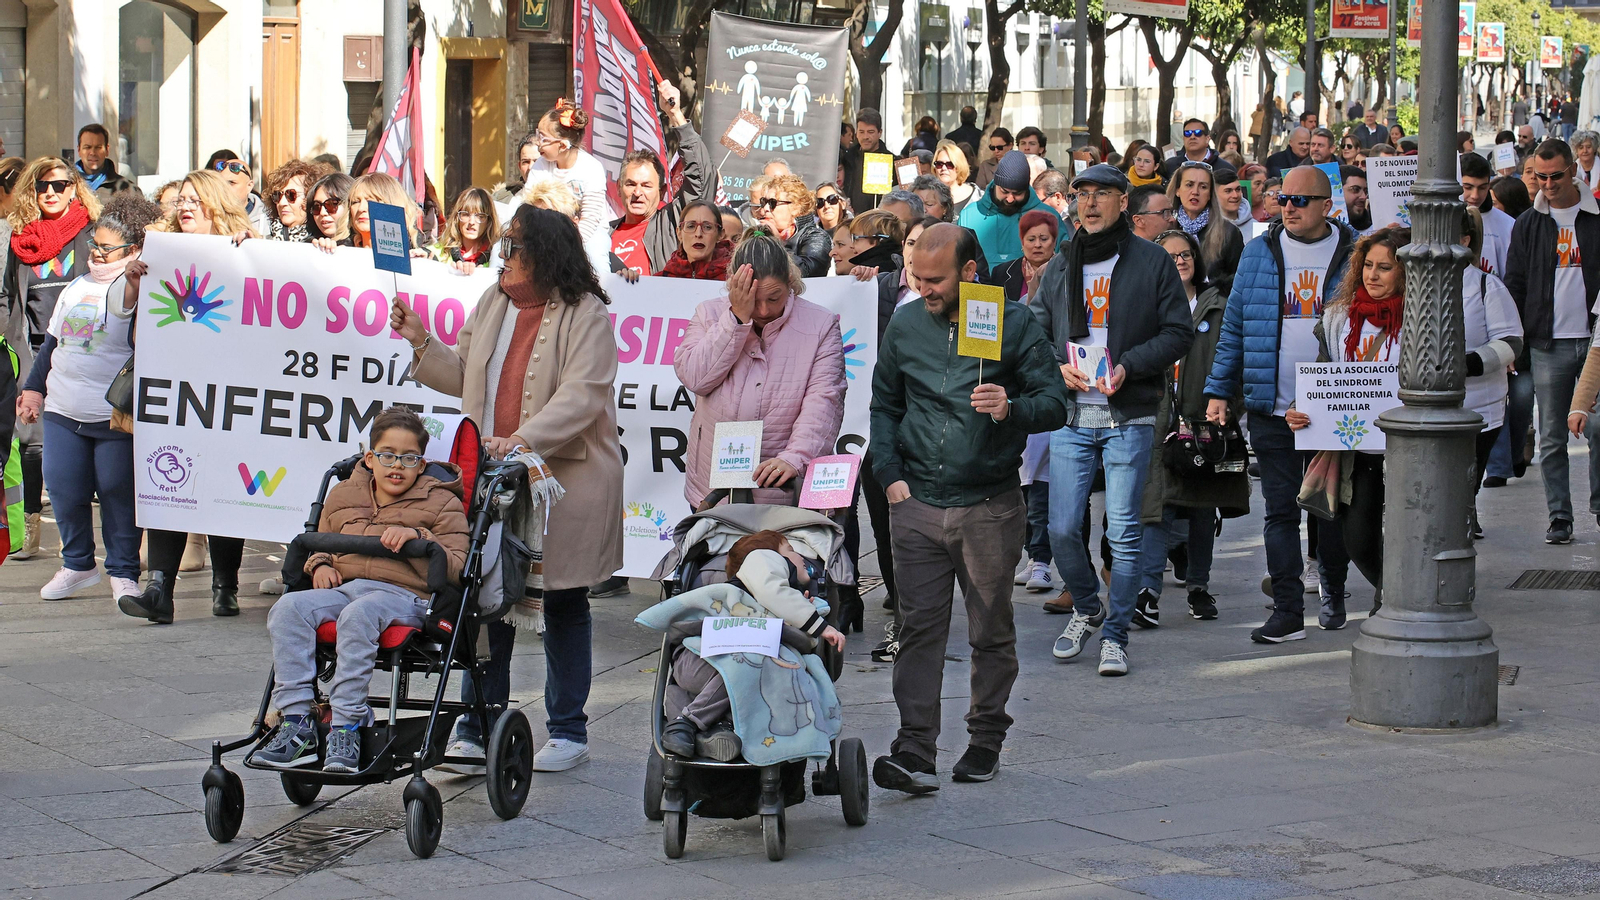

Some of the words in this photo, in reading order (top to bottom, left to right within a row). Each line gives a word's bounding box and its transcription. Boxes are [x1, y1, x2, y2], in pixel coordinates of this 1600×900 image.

[1339, 13, 1354, 27] 27
[1413, 29, 1421, 39] 2
[726, 44, 760, 59] Nunca
[762, 39, 799, 56] estarás
[800, 52, 827, 70] sol@
[1389, 159, 1417, 167] NOVIEM
[733, 177, 745, 188] 26
[1378, 180, 1415, 189] QUILOMICR
[378, 238, 403, 249] UNIPER
[241, 276, 308, 330] NO
[325, 285, 478, 346] SOMO
[968, 321, 997, 331] UNIPER
[282, 349, 319, 379] 28
[331, 354, 350, 381] F
[1300, 366, 1328, 375] SOMOS
[1330, 366, 1342, 374] LA
[1316, 379, 1332, 387] DEL
[1334, 378, 1382, 386] SINDROME
[1306, 390, 1393, 400] QUILOMICRONEMIA
[1327, 403, 1371, 411] FAMILIAR
[186, 456, 193, 468] de
[719, 457, 751, 466] UNIPER
[812, 478, 846, 486] UNIPER
[159, 484, 177, 493] Rett
[138, 493, 170, 502] Asociación
[171, 496, 198, 504] Española
[630, 525, 658, 535] Deletions
[712, 617, 768, 631] UNIPER
